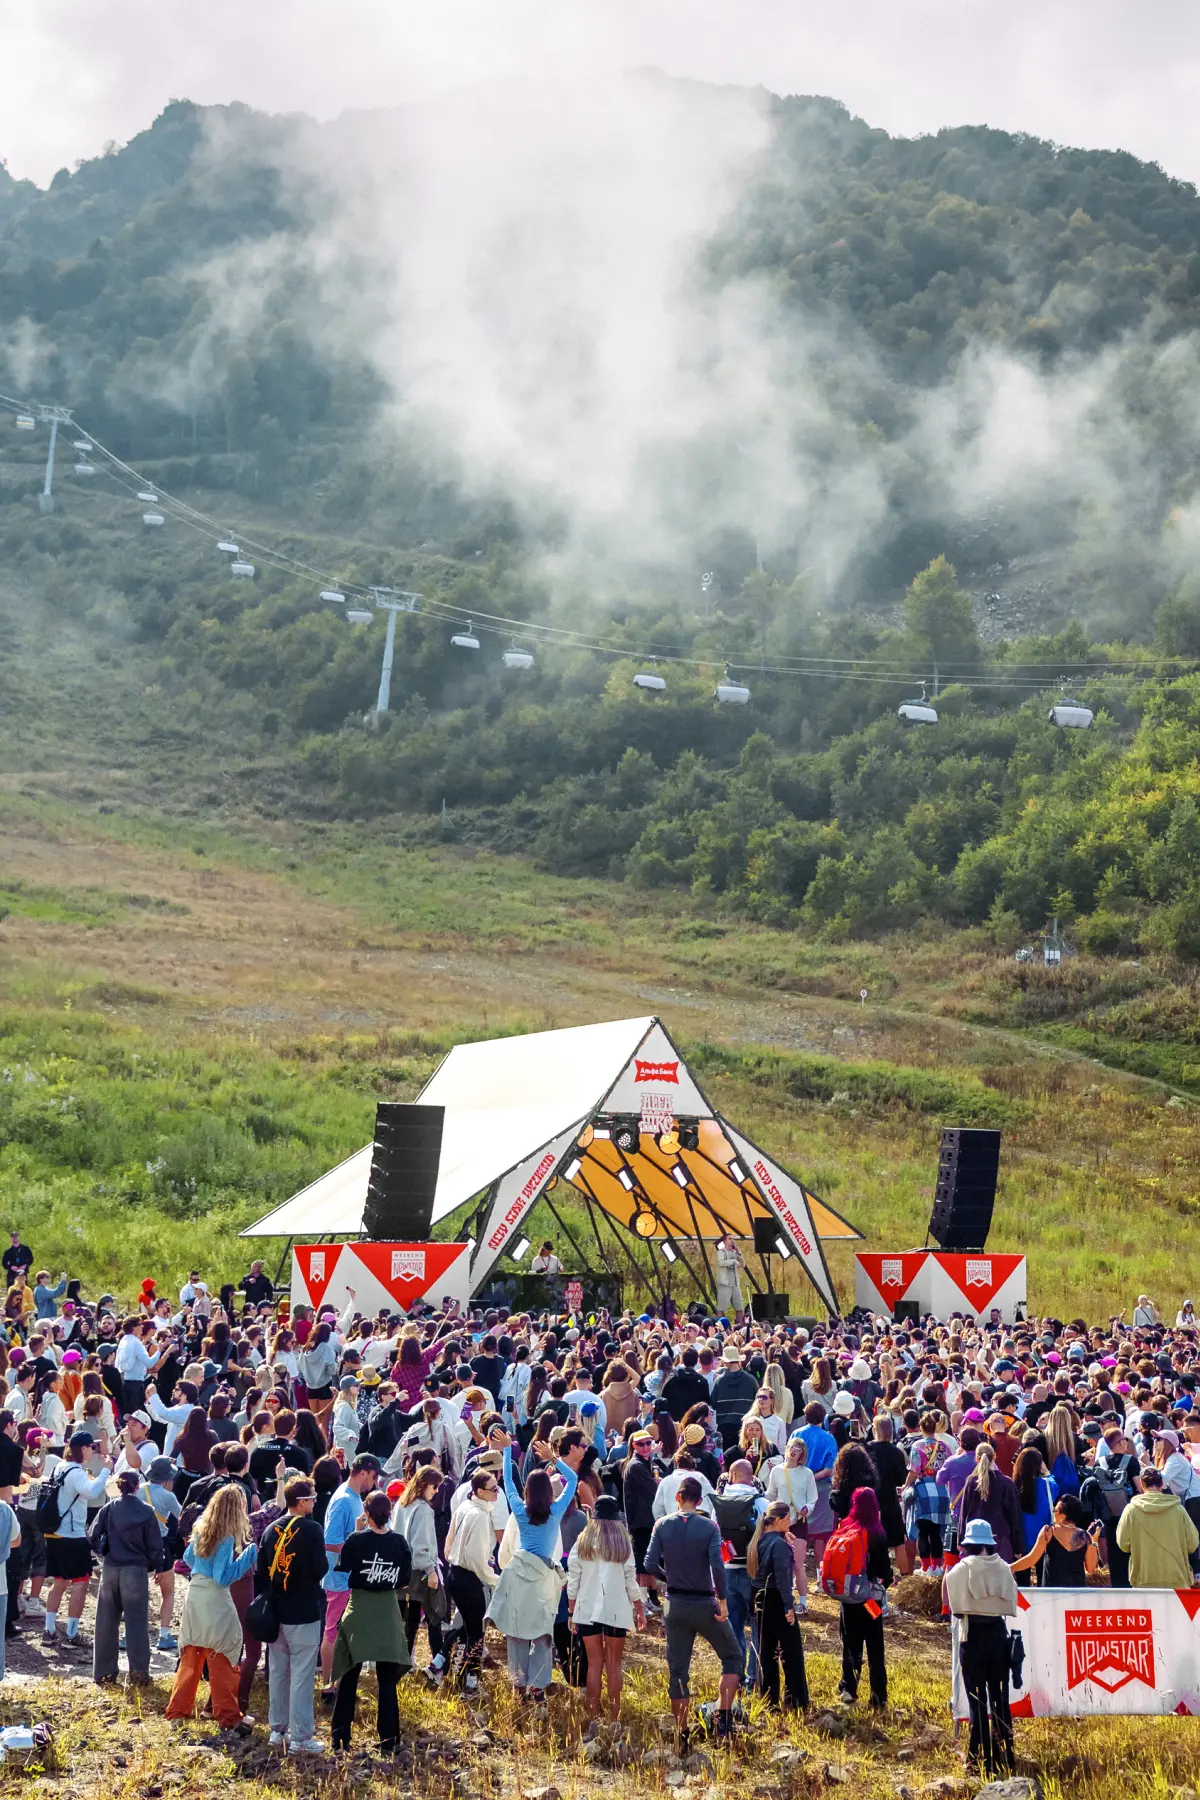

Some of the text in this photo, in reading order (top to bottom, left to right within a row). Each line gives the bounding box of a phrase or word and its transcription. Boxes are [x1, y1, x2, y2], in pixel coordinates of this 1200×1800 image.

[488, 1153, 556, 1250] NEW STAR WEEKEND
[754, 1160, 811, 1256] NEW STAR WEEKEND
[1071, 1615, 1147, 1627] WEEKEND
[1071, 1640, 1150, 1679] NEWSTAR
